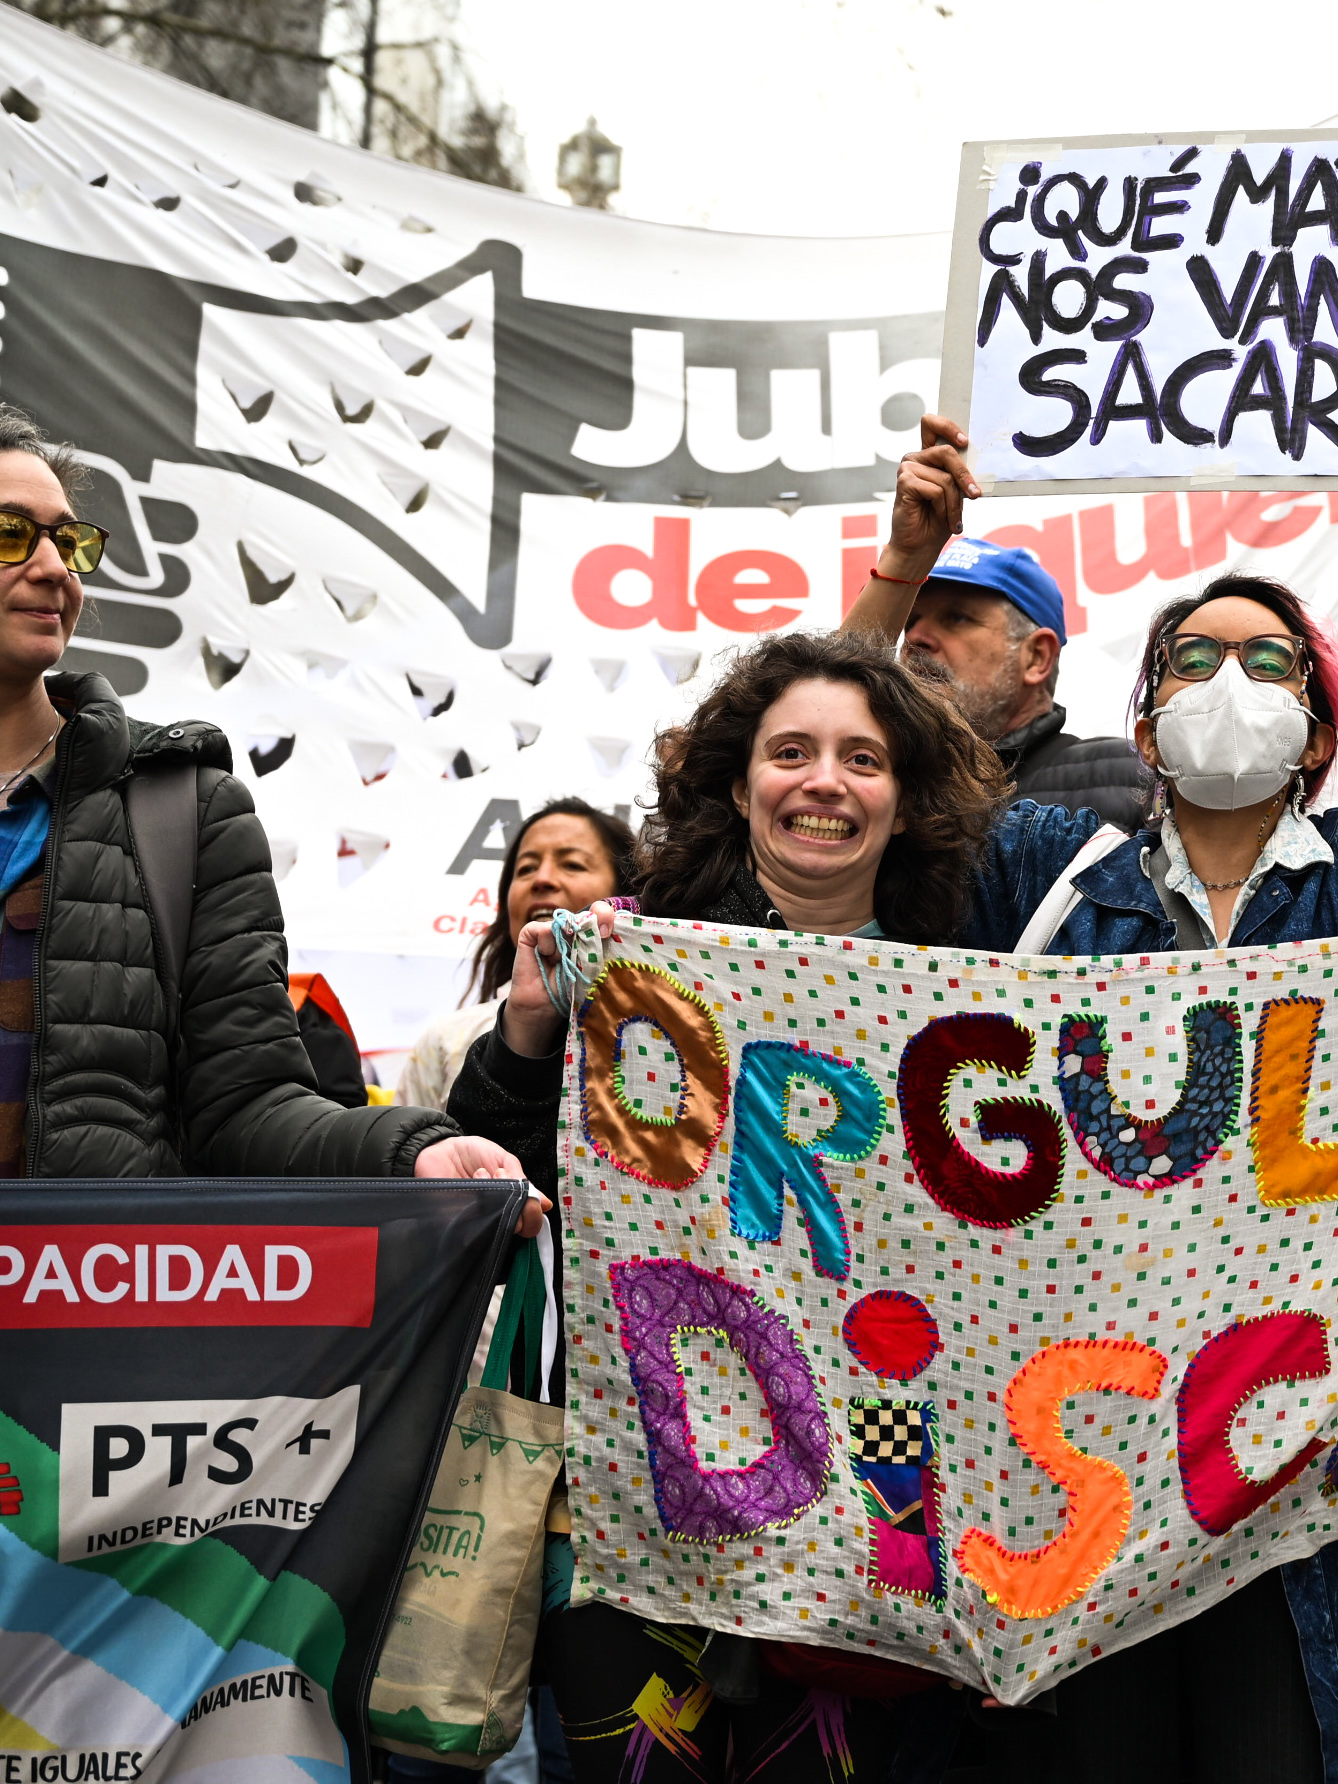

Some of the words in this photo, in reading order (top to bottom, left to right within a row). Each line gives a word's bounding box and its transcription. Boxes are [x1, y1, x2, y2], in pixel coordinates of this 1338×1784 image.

[979, 145, 1201, 268] ¿QUÉ
[977, 249, 1155, 348] NOS
[571, 516, 810, 634] de
[92, 1417, 260, 1498] PTS
[86, 1497, 324, 1553] INDEPENDIENTES
[180, 1671, 314, 1730] ANAMENTE
[31, 1751, 143, 1784] IGUALES
